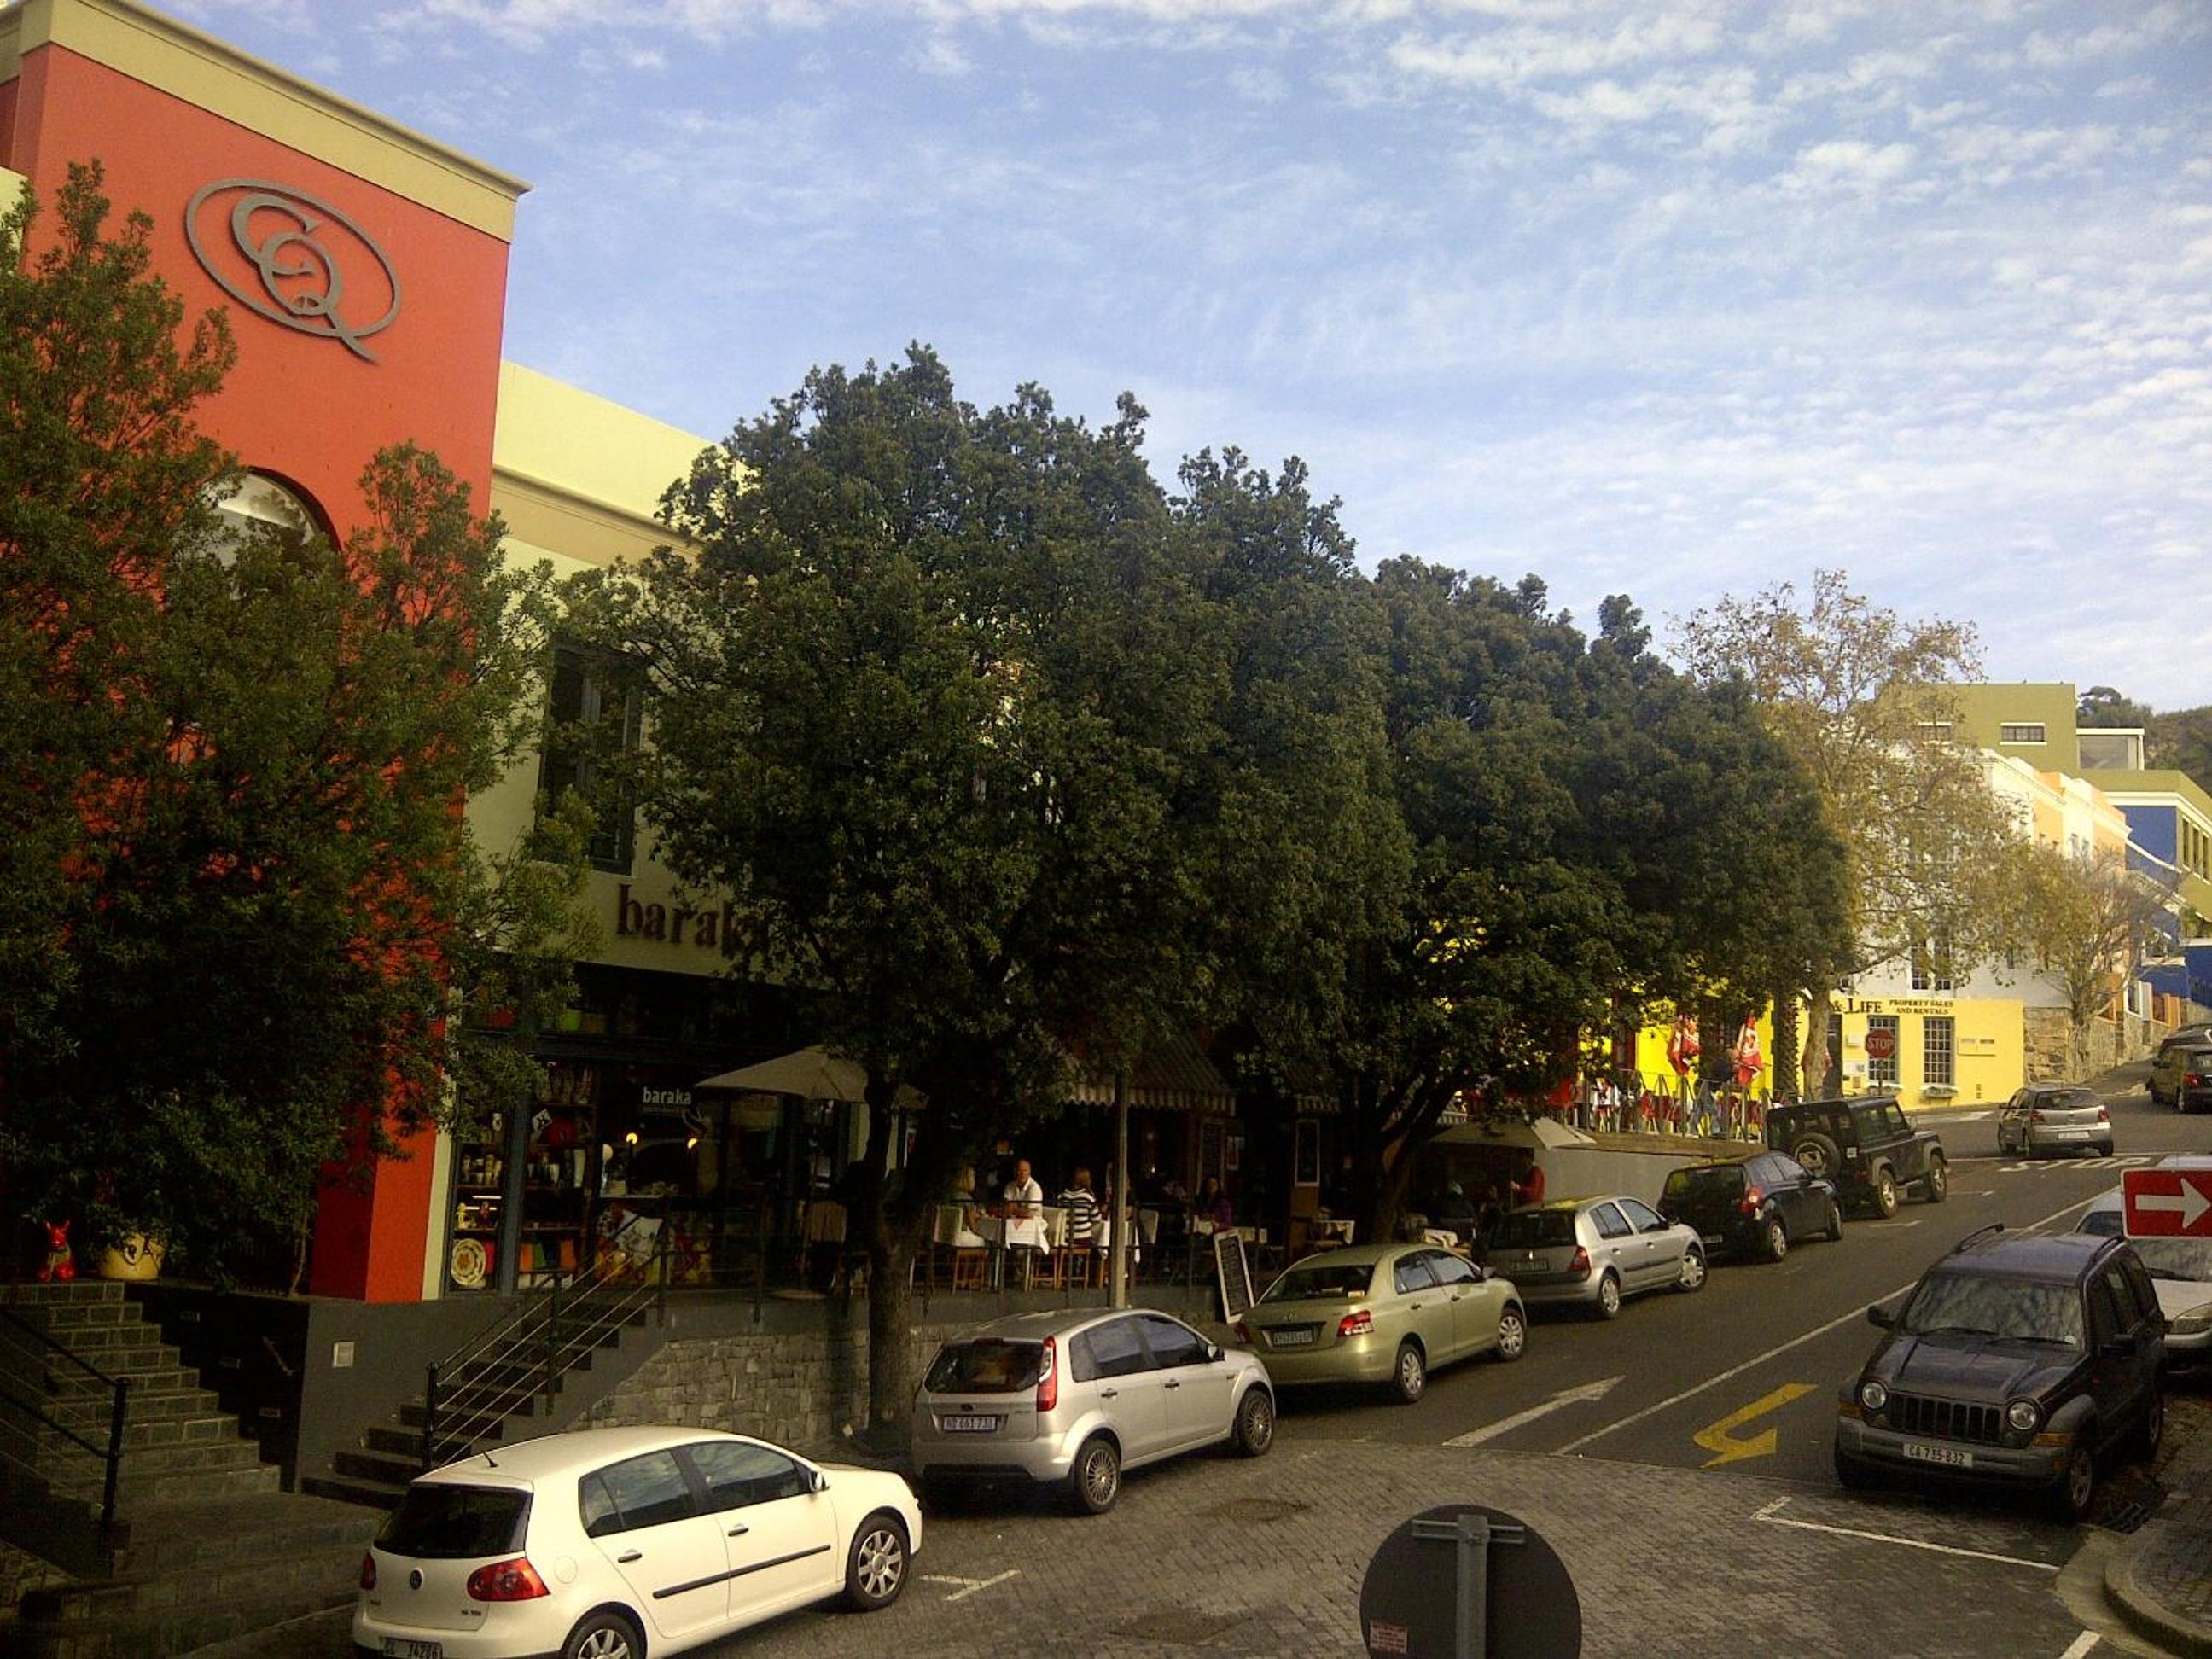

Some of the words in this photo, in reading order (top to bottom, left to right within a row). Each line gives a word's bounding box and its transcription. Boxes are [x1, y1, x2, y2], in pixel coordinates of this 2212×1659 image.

[615, 882, 770, 961] barak
[1844, 998, 1883, 1014] LIFE
[1867, 1038, 1895, 1051] STOP
[642, 1086, 692, 1105] baraka
[1998, 1156, 2151, 1173] STOP
